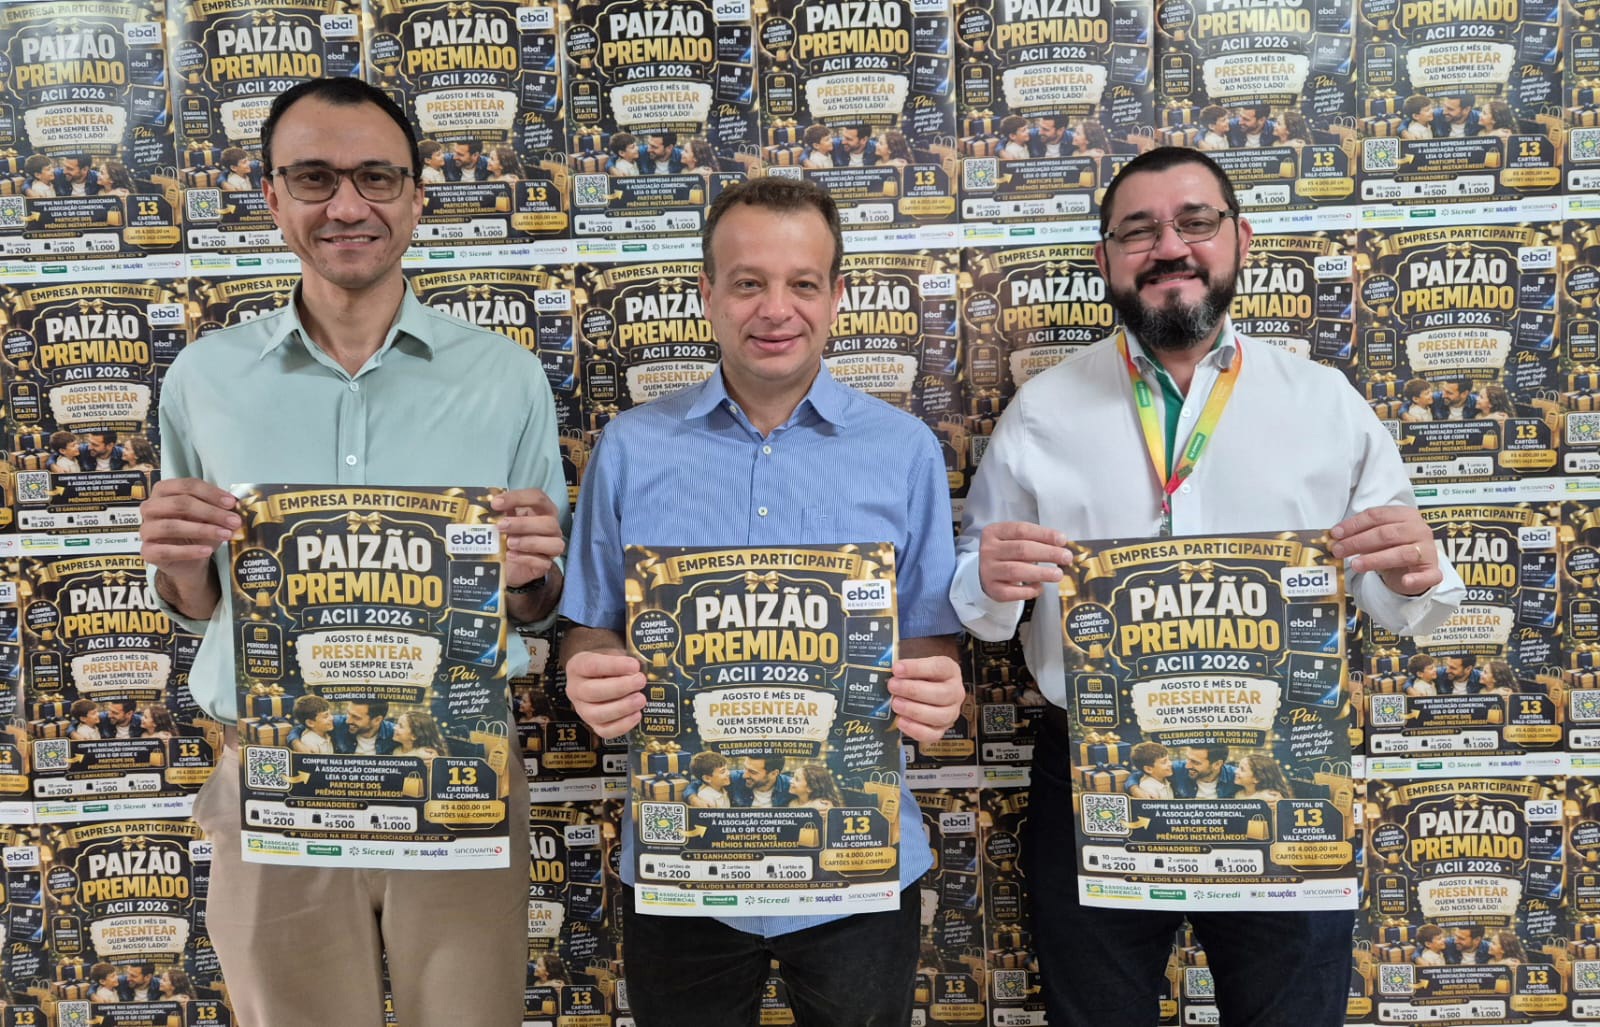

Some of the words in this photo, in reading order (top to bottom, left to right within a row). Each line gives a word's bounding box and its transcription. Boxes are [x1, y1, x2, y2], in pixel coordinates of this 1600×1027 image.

[413, 13, 507, 47] PAIZÃO
[609, 5, 703, 40] PAIZÃO
[1197, 8, 1310, 38] PREMIADO
[217, 21, 312, 55] PAIZÃO
[996, 19, 1107, 49] PREMIADO
[1425, 26, 1454, 40] ACII
[1459, 25, 1495, 36] 2026
[21, 28, 115, 63] PAIZÃO
[799, 29, 908, 59] PREMIADO
[1220, 37, 1249, 51] ACII
[1254, 36, 1288, 47] 2026
[602, 37, 712, 66] PREMIADO
[1020, 47, 1047, 61] ACII
[1052, 47, 1086, 58] 2026
[407, 45, 516, 74] PREMIADO
[822, 57, 849, 71] ACII
[854, 57, 887, 68] 2026
[1418, 52, 1501, 67] PRESENTEAR
[15, 60, 125, 89] PREMIADO
[211, 53, 321, 82] PREMIADO
[627, 65, 654, 79] ACII
[658, 65, 691, 76] 2026
[431, 73, 458, 86] ACII
[463, 73, 496, 84] 2026
[40, 88, 67, 101] ACII
[71, 88, 104, 98] 2026
[817, 83, 895, 97] PRESENTEAR
[426, 99, 504, 112] PRESENTEAR
[621, 92, 699, 105] PRESENTEAR
[35, 114, 113, 127] PRESENTEAR
[1519, 141, 1540, 156] 13
[1397, 231, 1446, 245] EMPRESA
[1450, 229, 1527, 239] PARTICIPANTE
[1521, 250, 1551, 262] eba!
[1410, 253, 1506, 288] PAIZÃO
[922, 278, 950, 289] eba!
[30, 287, 78, 301] EMPRESA
[81, 286, 153, 296] PARTICIPANTE
[1401, 285, 1514, 314] PREMIADO
[151, 307, 178, 318] eba!
[1424, 313, 1452, 326] ACII
[1457, 312, 1491, 323] 2026
[45, 309, 139, 343] PAIZÃO
[1417, 338, 1498, 351] PRESENTEAR
[39, 340, 148, 368] PREMIADO
[64, 367, 91, 380] ACII
[95, 367, 128, 377] 2026
[60, 392, 138, 405] PRESENTEAR
[279, 493, 346, 511] EMPRESA
[353, 495, 458, 512] PARTICIPANTE
[451, 530, 491, 544] eba!
[1521, 530, 1550, 541] eba!
[298, 528, 431, 571] PAIZÃO
[1110, 545, 1178, 564] EMPRESA
[1183, 542, 1292, 556] PARTICIPANTE
[677, 554, 744, 572] EMPRESA
[750, 553, 854, 570] PARTICIPANTE
[1286, 572, 1329, 587] eba!
[287, 571, 442, 607] PREMIADO
[846, 586, 885, 599] eba!
[1130, 575, 1267, 621] PAIZÃO
[319, 608, 358, 624] ACII
[365, 608, 412, 625] 2026
[696, 587, 827, 631] PAIZÃO
[1075, 612, 1102, 621] COMPRE
[62, 611, 169, 638] PREMIADO
[1079, 617, 1109, 627] COMÉRCIO
[87, 637, 113, 649] ACII
[117, 637, 149, 647] 2026
[325, 634, 363, 643] AGOSTO
[366, 634, 371, 642] É
[374, 634, 393, 643] MÊS
[397, 636, 408, 644] DE
[1074, 632, 1110, 642] CONCORRA!
[1120, 618, 1279, 655] PREMIADO
[311, 644, 422, 660] PRESENTEAR
[685, 630, 838, 665] PREMIADO
[319, 660, 346, 669] QUEM
[349, 661, 386, 669] SEMPRE
[390, 660, 413, 669] ESTÁ
[1155, 655, 1194, 672] ACII
[1200, 655, 1249, 669] 2026
[326, 670, 339, 678] AO
[342, 670, 375, 678] NOSSO
[379, 671, 408, 679] LADO!
[448, 665, 479, 682] Pai,
[717, 666, 755, 683] ACII
[762, 666, 809, 681] 2026
[1161, 681, 1200, 690] AGOSTO
[1211, 679, 1231, 688] MÊS
[1234, 680, 1247, 688] DE
[722, 692, 760, 700] AGOSTO
[763, 691, 768, 699] É
[772, 690, 790, 699] MÊS
[1147, 690, 1261, 706] PRESENTEAR
[709, 701, 818, 716] PRESENTEAR
[1156, 707, 1184, 715] QUEM
[1186, 706, 1225, 714] SEMPRE
[1229, 704, 1252, 713] ESTÁ
[1520, 700, 1540, 713] 13
[747, 717, 784, 725] SEMPRE
[787, 716, 809, 725] ESTÁ
[1163, 716, 1177, 724] AO
[1180, 715, 1214, 723] NOSSO
[1217, 715, 1247, 723] LADO!
[1289, 707, 1321, 724] Pai,
[776, 726, 804, 734] LADO!
[843, 719, 873, 736] Pai,
[448, 766, 476, 785] 13
[843, 816, 870, 833] 13
[1293, 808, 1323, 826] 13
[1419, 805, 1513, 837] PAIZÃO
[361, 847, 394, 856] Sicredi
[1411, 835, 1521, 861] PREMIADO
[89, 846, 180, 878] PAIZÃO
[1177, 864, 1198, 872] 500
[1228, 864, 1257, 872] 1.000
[1435, 861, 1462, 873] ACII
[1467, 861, 1500, 872] 2026
[83, 876, 188, 902] PREMIADO
[106, 901, 132, 914] ACII
[136, 901, 168, 911] 2026
